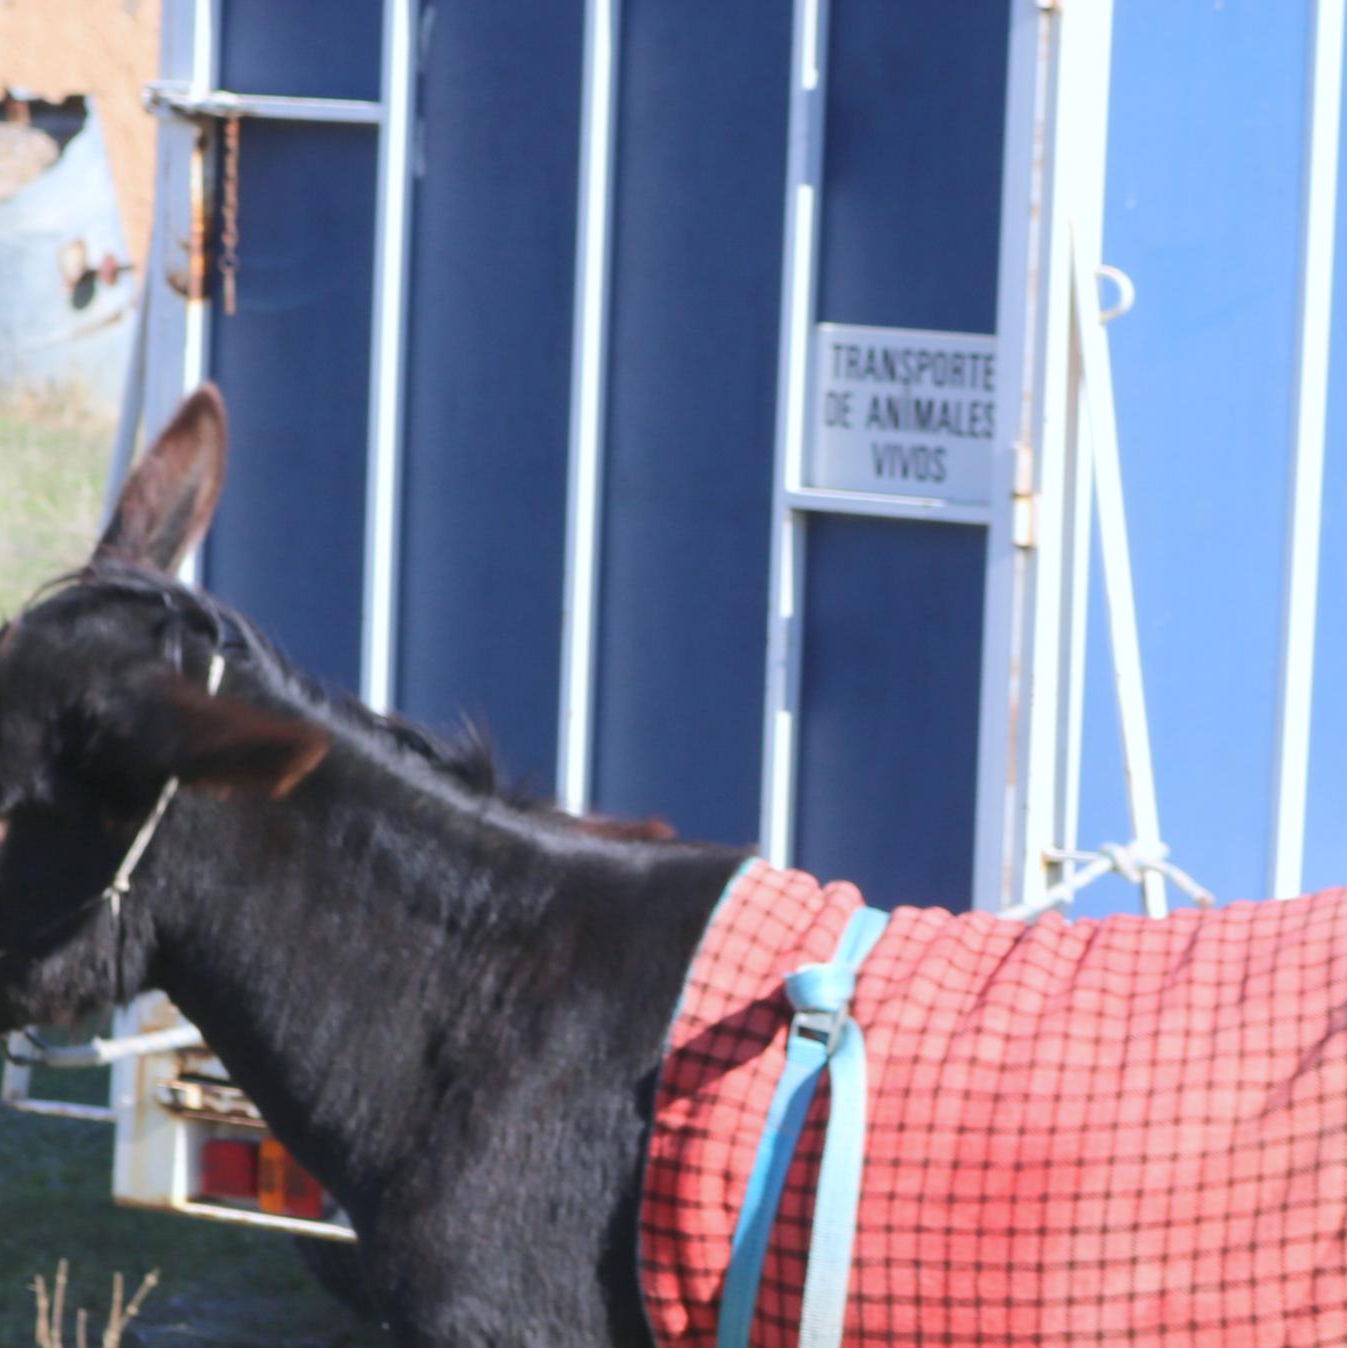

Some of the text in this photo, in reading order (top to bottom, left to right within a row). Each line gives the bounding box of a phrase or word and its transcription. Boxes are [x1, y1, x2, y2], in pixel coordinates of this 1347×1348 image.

[832, 343, 996, 392] TRANSPORTE
[824, 390, 996, 440] DE ANIMALES
[871, 442, 947, 483] VIVOS
